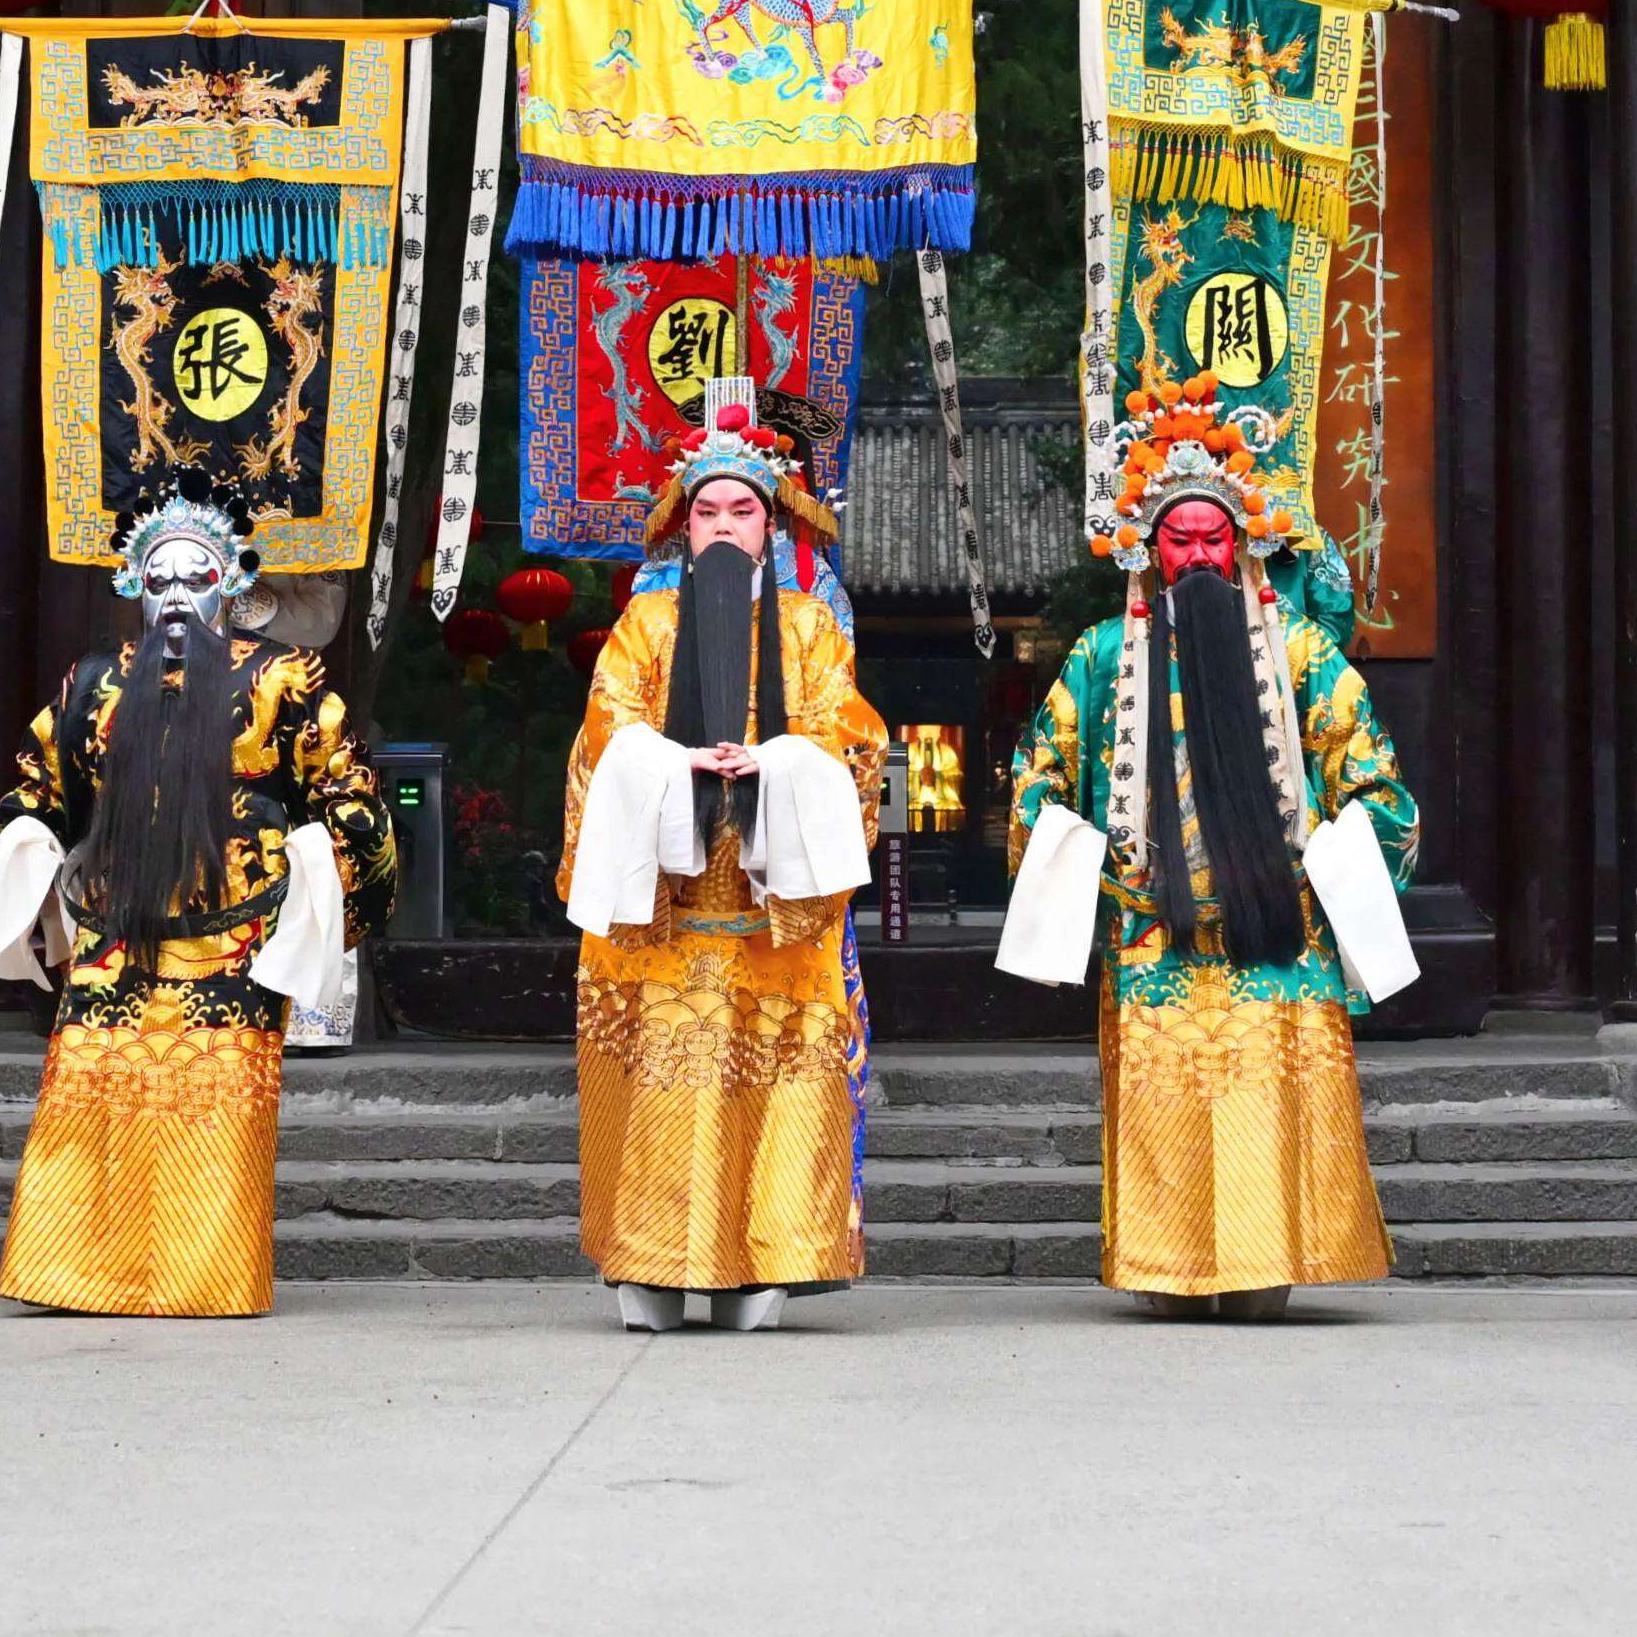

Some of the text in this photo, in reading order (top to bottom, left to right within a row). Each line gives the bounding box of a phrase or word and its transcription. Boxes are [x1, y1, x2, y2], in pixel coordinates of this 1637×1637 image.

[178, 317, 263, 401] 張
[657, 305, 729, 386] 劉
[1201, 278, 1274, 381] 關
